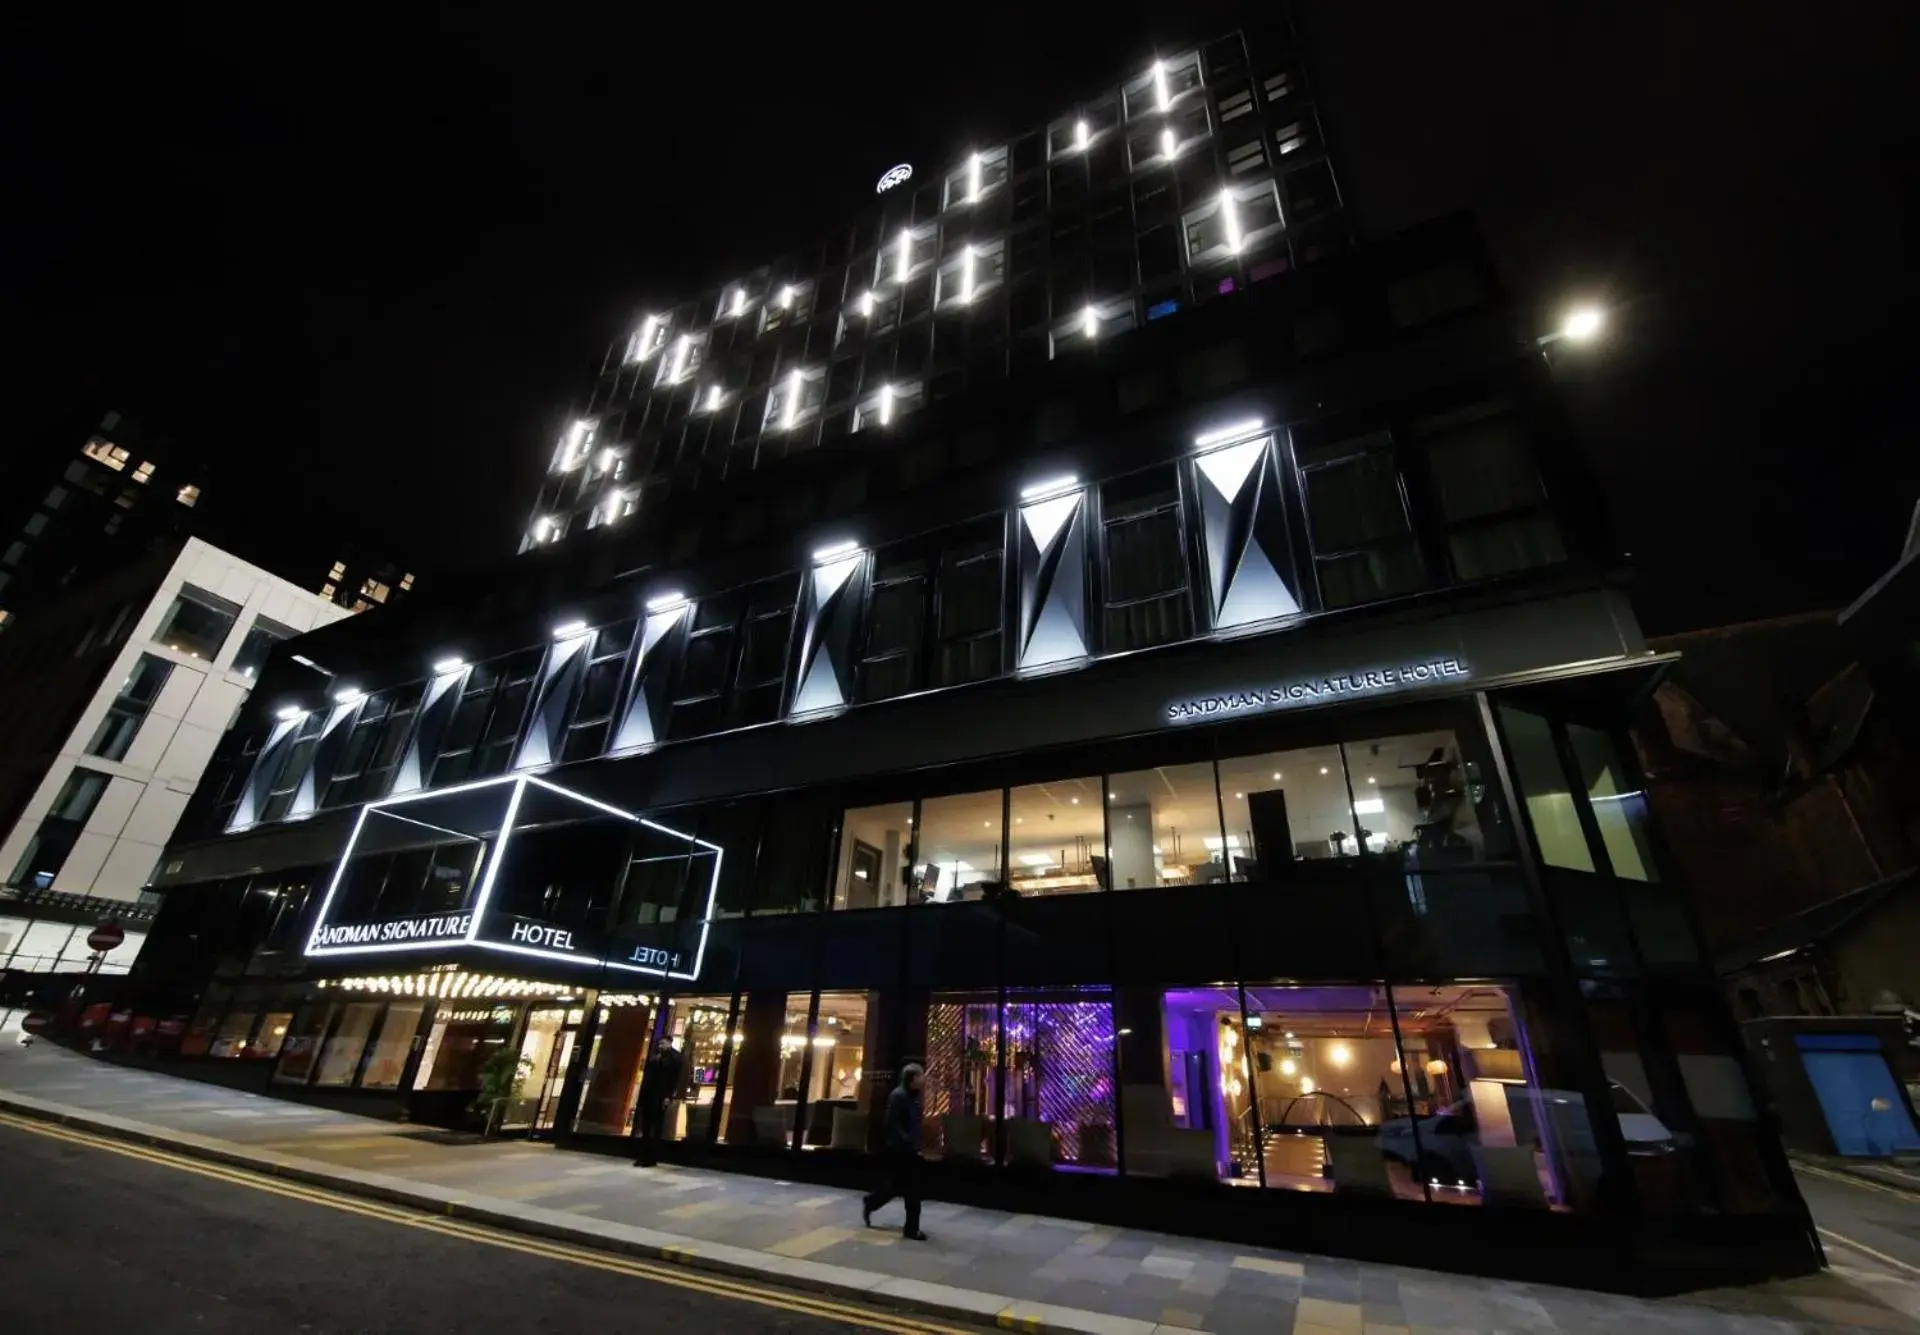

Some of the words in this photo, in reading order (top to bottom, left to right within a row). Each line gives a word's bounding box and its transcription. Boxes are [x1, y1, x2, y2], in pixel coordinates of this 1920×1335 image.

[1167, 689, 1266, 720] SANDMAN
[1270, 668, 1396, 702] SIGNATURE
[1399, 656, 1469, 684] HOTEL
[313, 923, 381, 945] SANDMAN
[381, 915, 471, 941] SIGNATURE
[511, 922, 575, 950] HOTEL
